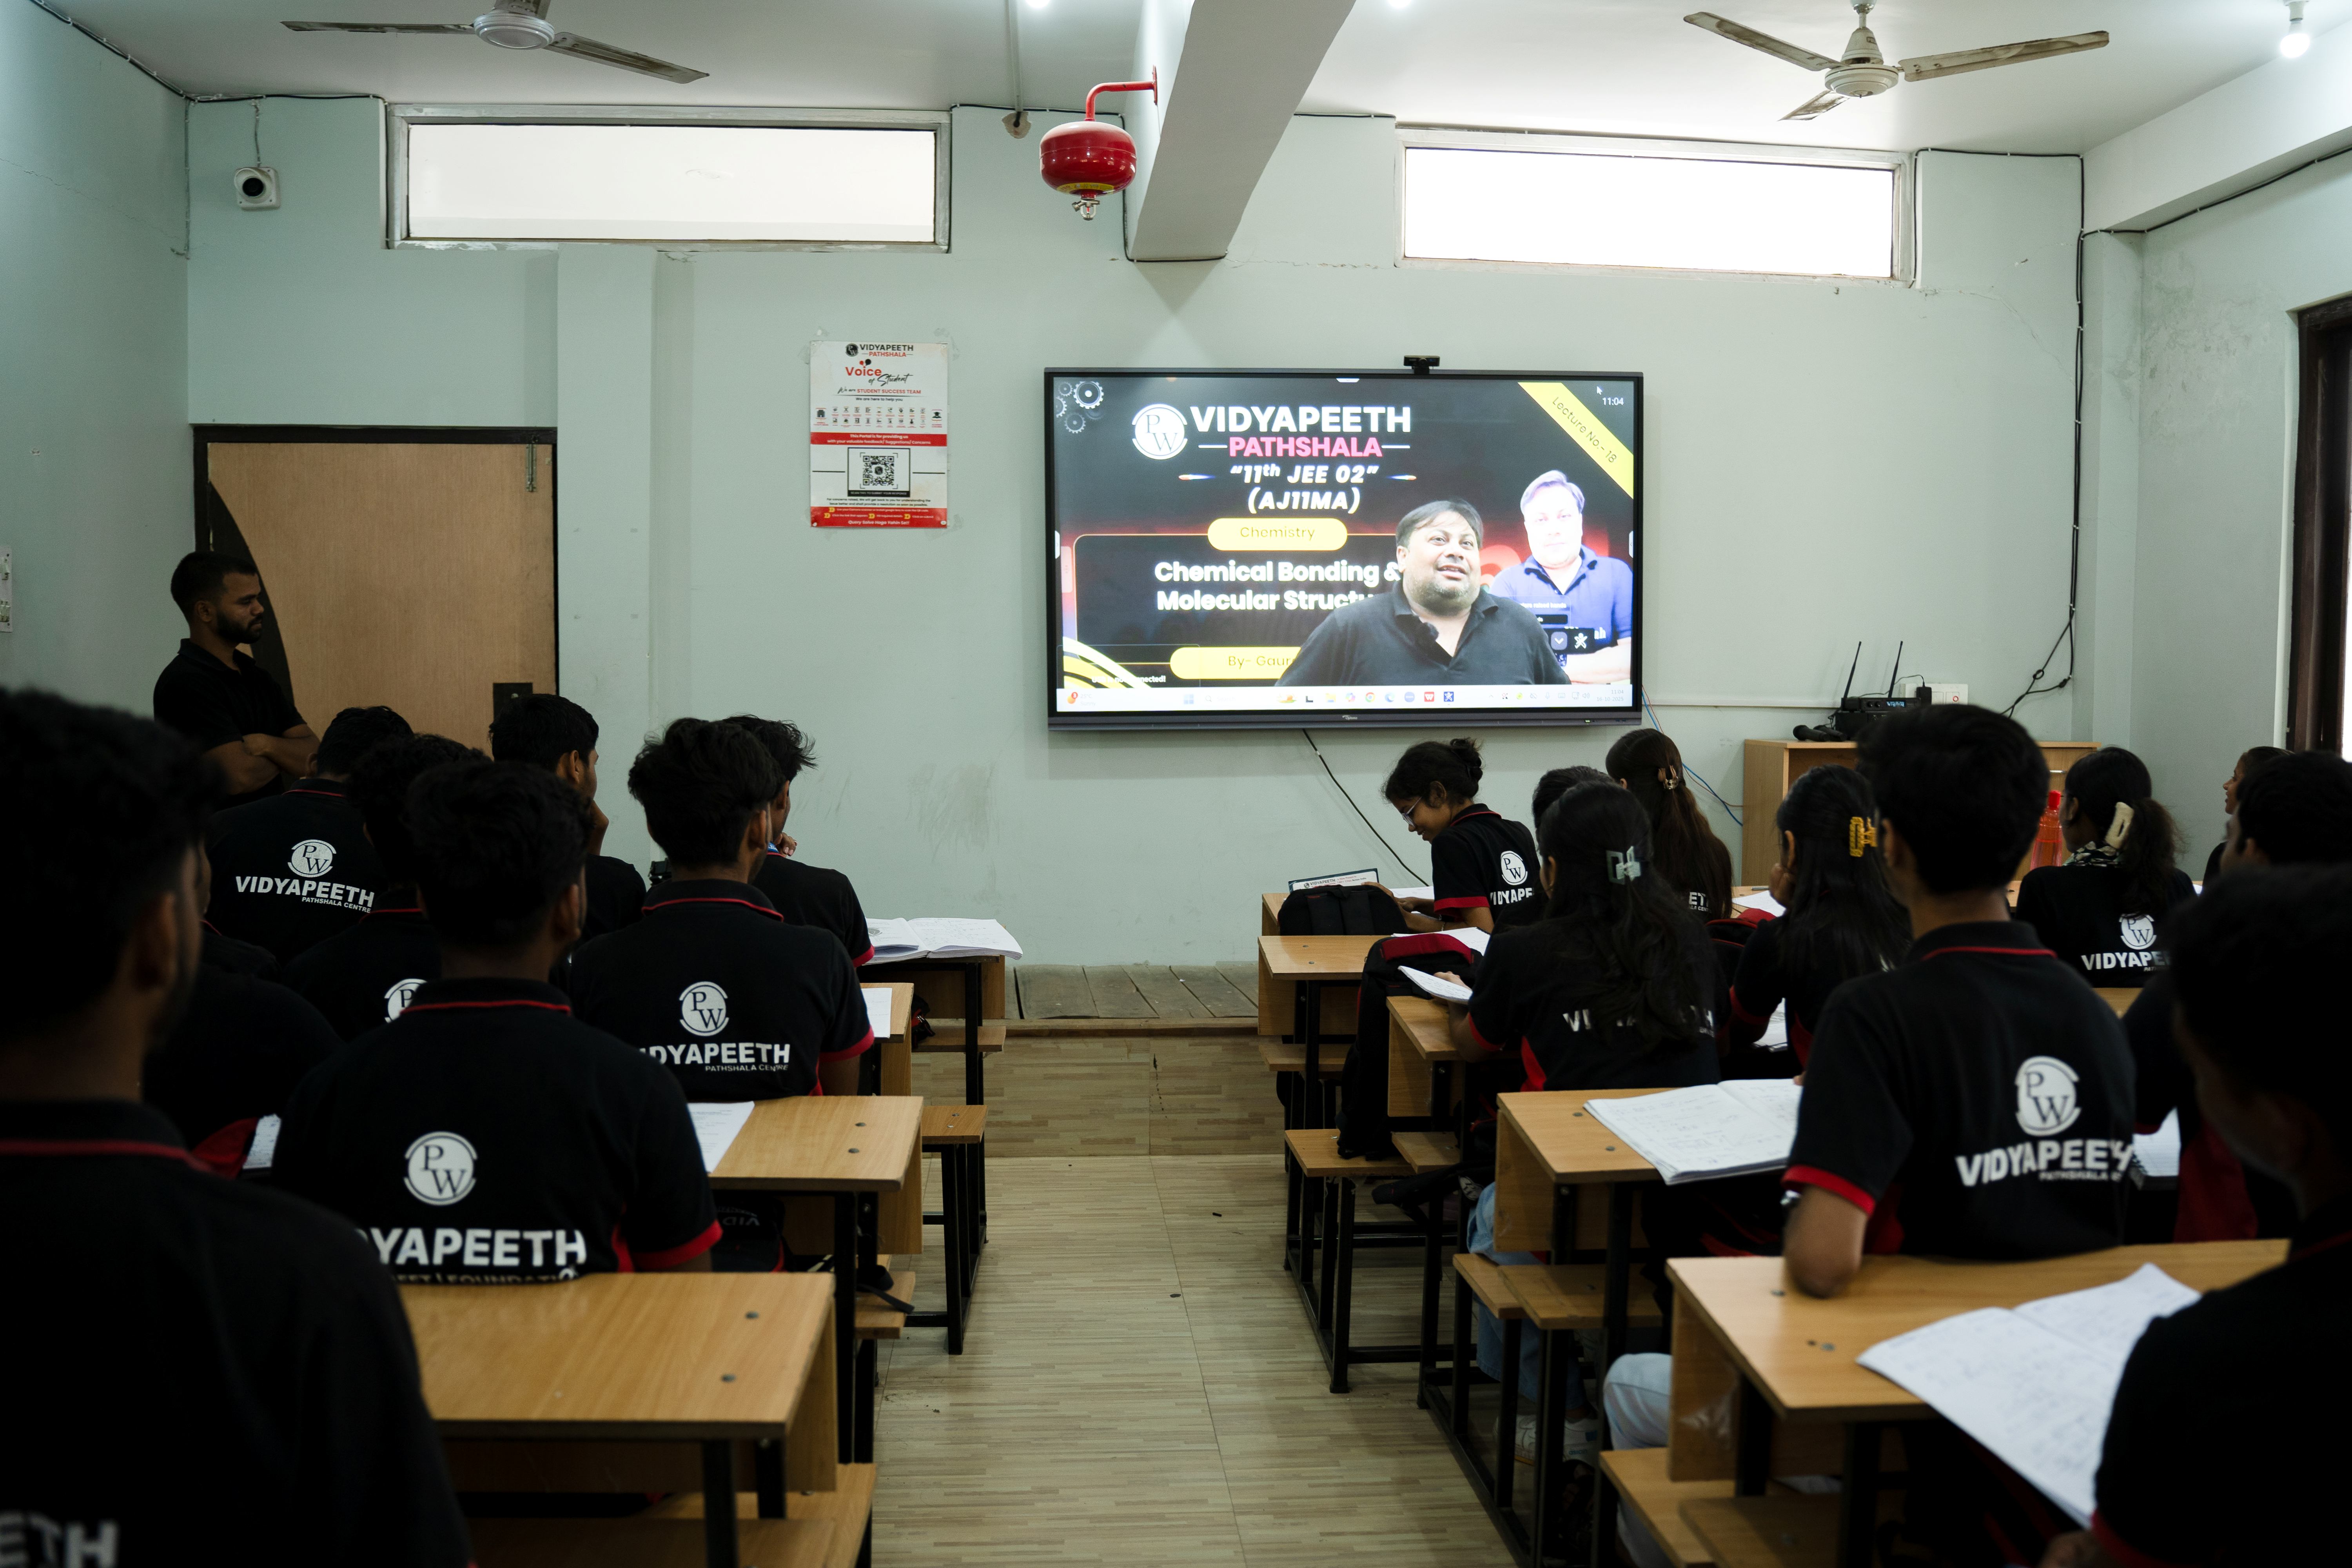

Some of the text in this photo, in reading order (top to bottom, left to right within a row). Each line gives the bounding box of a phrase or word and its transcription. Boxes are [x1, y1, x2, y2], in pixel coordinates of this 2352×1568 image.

[845, 366, 882, 376] Voice
[877, 373, 914, 387] Student
[1602, 397, 1624, 406] 11:04
[1190, 406, 1411, 433] VIDYAPEETH
[1552, 397, 1586, 433] Lecture
[1229, 437, 1383, 457] PATHSHALA
[1287, 465, 1329, 483] JEE
[1240, 527, 1315, 541] Chemistry
[1154, 559, 1401, 588] Chemical Bonding &
[1157, 589, 1373, 610] Molecular Struct
[1229, 656, 1251, 669] By-
[236, 876, 374, 907] VIDYAPEETH
[301, 896, 371, 913] PATHSHALA CENTRE
[639, 1042, 790, 1065] DYAPEETH
[759, 1063, 789, 1072] CENTRE
[355, 1227, 587, 1267] YAPEETH
